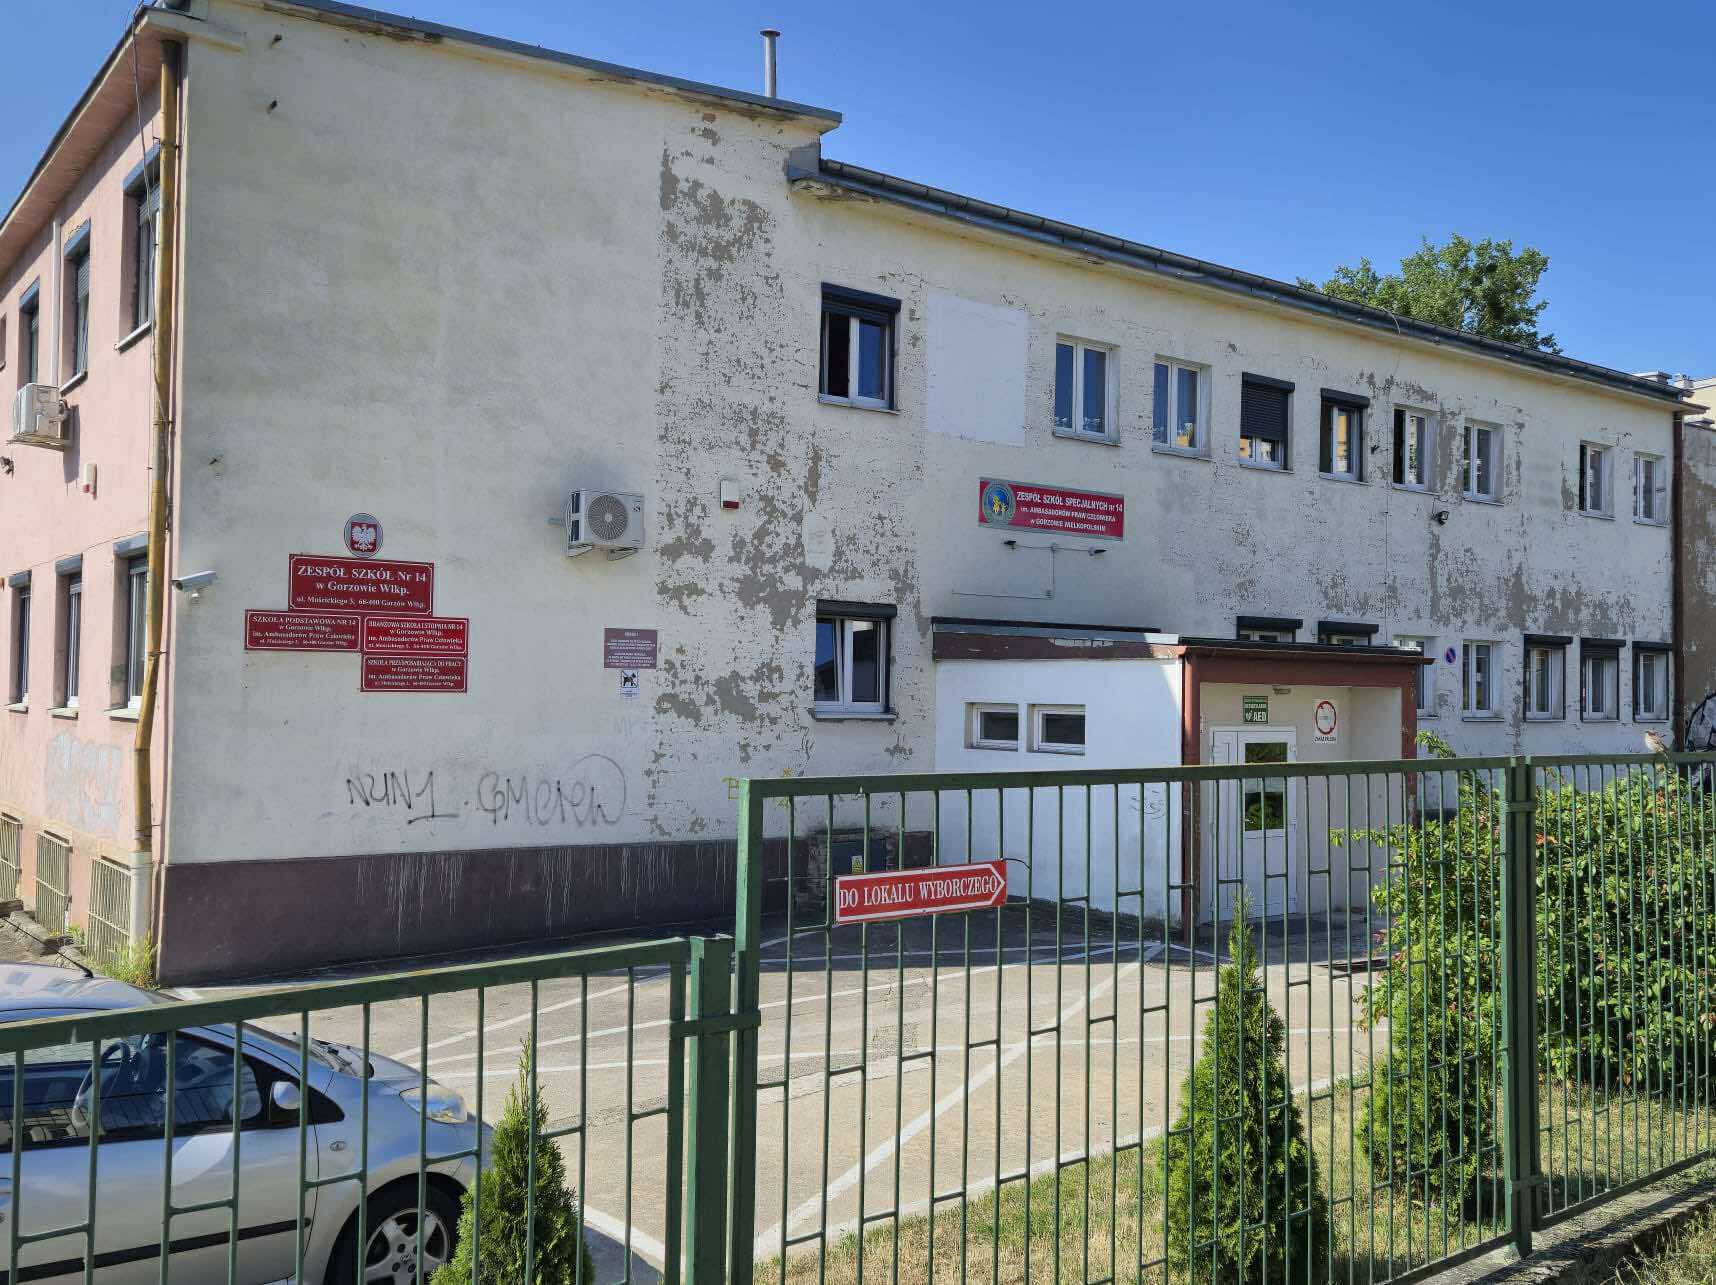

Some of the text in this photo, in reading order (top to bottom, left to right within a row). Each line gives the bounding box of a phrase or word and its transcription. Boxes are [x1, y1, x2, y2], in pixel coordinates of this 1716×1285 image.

[1017, 491, 1041, 502] ZESPÓŁ
[1043, 493, 1063, 504] SZKÓŁ
[1065, 497, 1108, 511] SPECJALNYCH
[297, 564, 426, 582] ZESPÓŁ SZKÓŁ Nr 14
[327, 581, 377, 593] Gorzowie
[380, 583, 410, 596] Wlkp.
[1253, 711, 1266, 721] AED
[840, 875, 997, 909] DO LOKALU WYBORCZEGO
